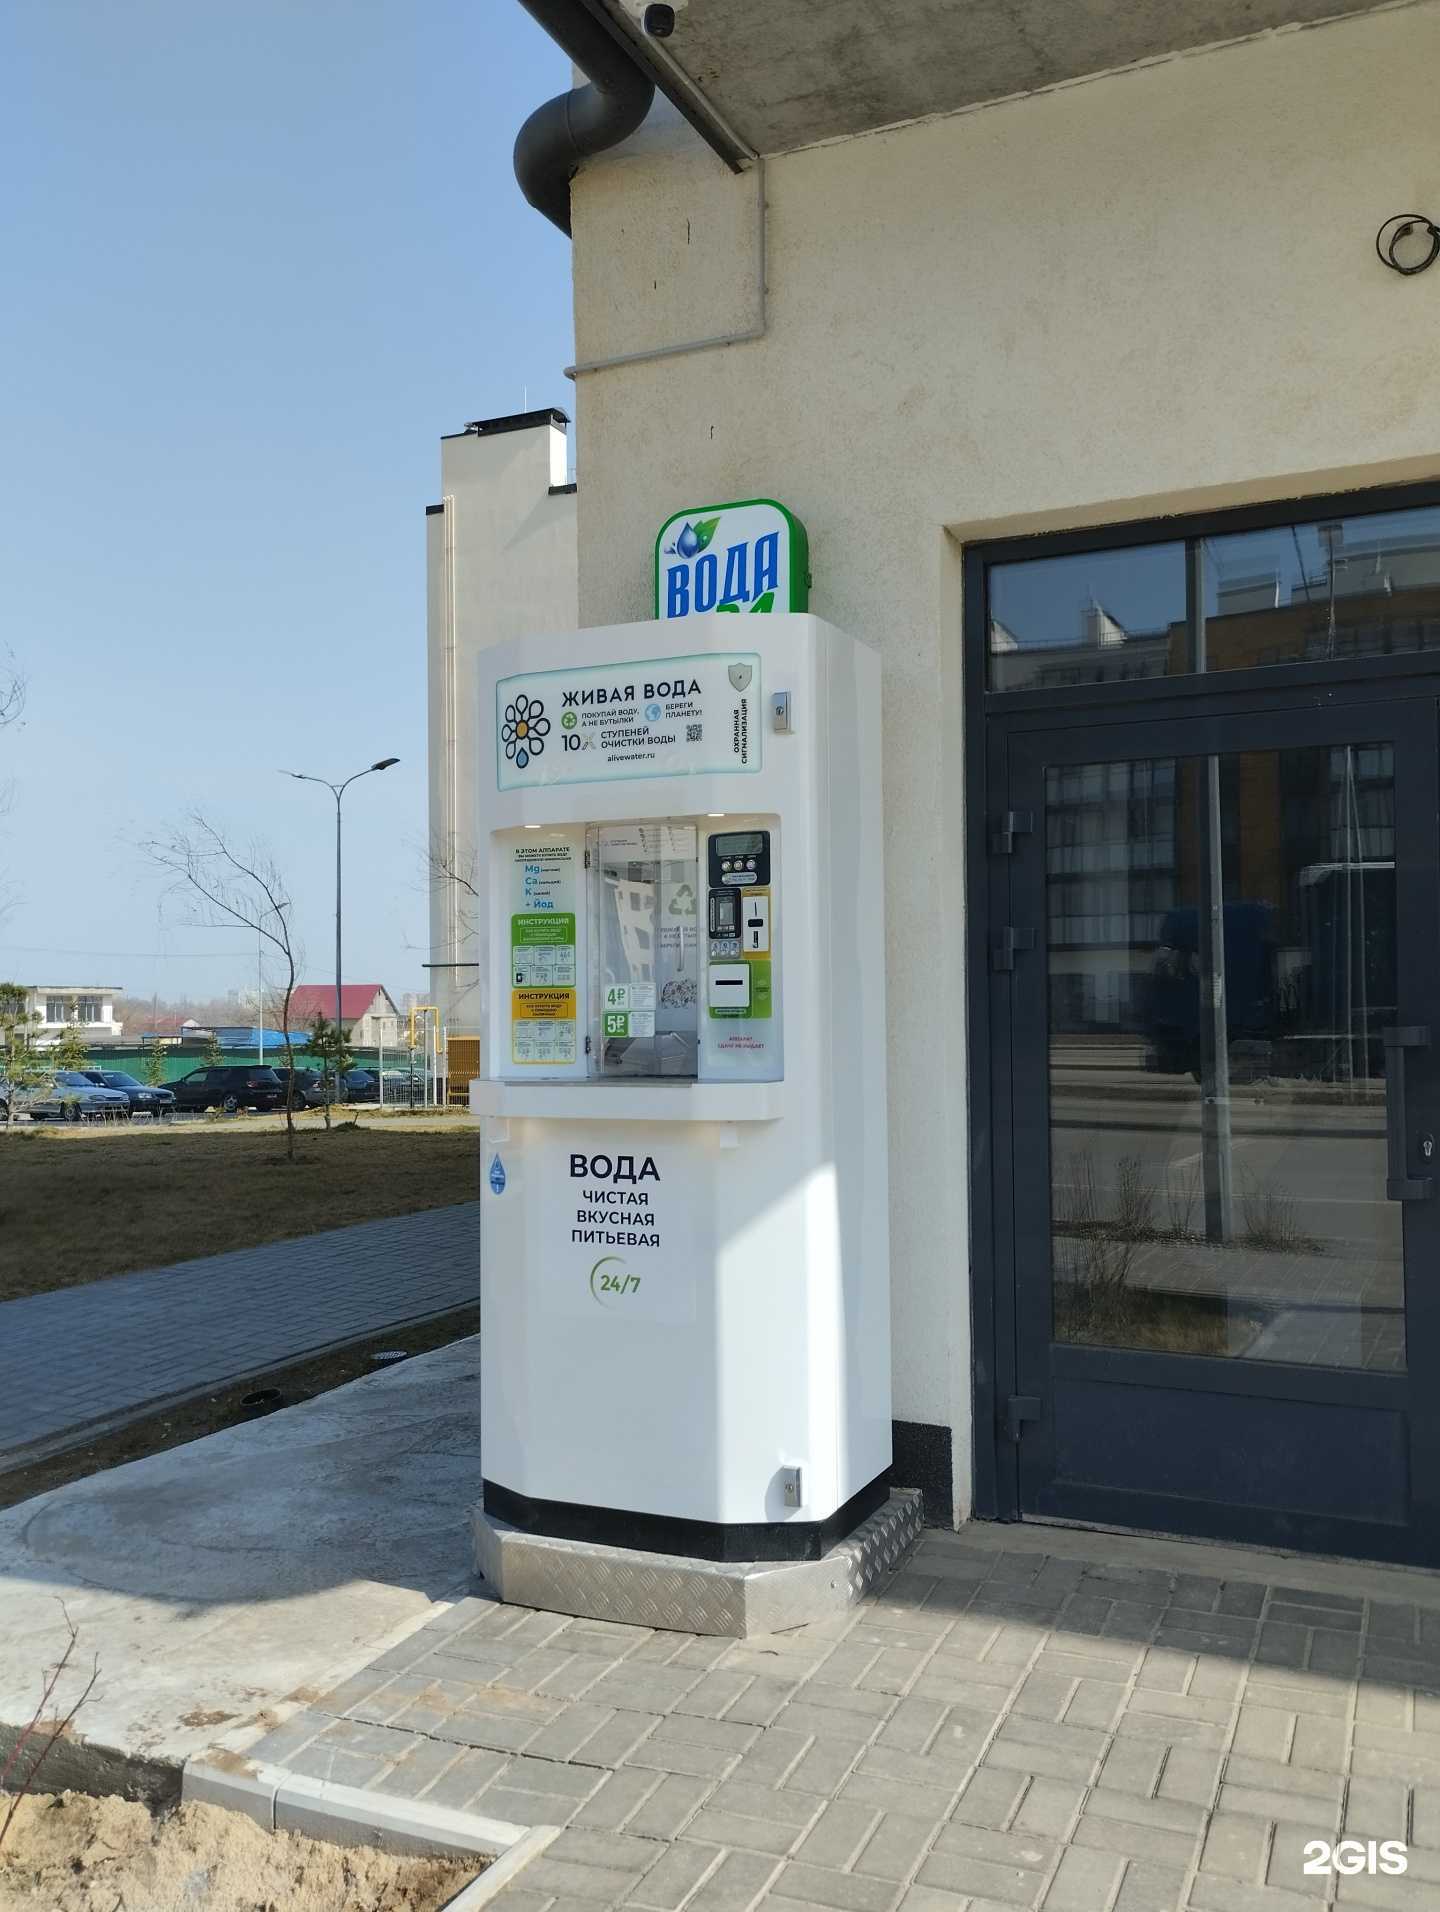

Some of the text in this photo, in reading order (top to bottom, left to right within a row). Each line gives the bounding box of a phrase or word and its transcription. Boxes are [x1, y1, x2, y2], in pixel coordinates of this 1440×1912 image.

[667, 531, 779, 619] ВОДА
[561, 679, 702, 707] ЖИВАЯ ВОДА
[665, 701, 693, 711] БЕРЕГИ
[581, 710, 617, 720] ПОКУПАЙ
[665, 709, 702, 719] ПЛАНЕТУ!
[588, 719, 598, 727] НЕ
[599, 716, 634, 726] БУТЫЛКИ
[601, 726, 650, 740] СТУПЕНЕЙ
[601, 734, 676, 749] ОЧИСТКИ ВОДЫ
[607, 752, 656, 763] alivewater.ru
[525, 865, 540, 874] Mg
[533, 898, 554, 909] Йод
[517, 917, 569, 927] ИНСТРУКЦИЯ
[518, 992, 570, 1001] ИНСТРУКЦИЯ
[569, 1153, 661, 1185] ВОДА
[582, 1189, 649, 1206] ЧИСТАЯ
[576, 1209, 655, 1227] ВКУСНАЯ
[571, 1229, 661, 1248] ПИТЬЕВАЯ
[600, 1274, 641, 1295] 24/7
